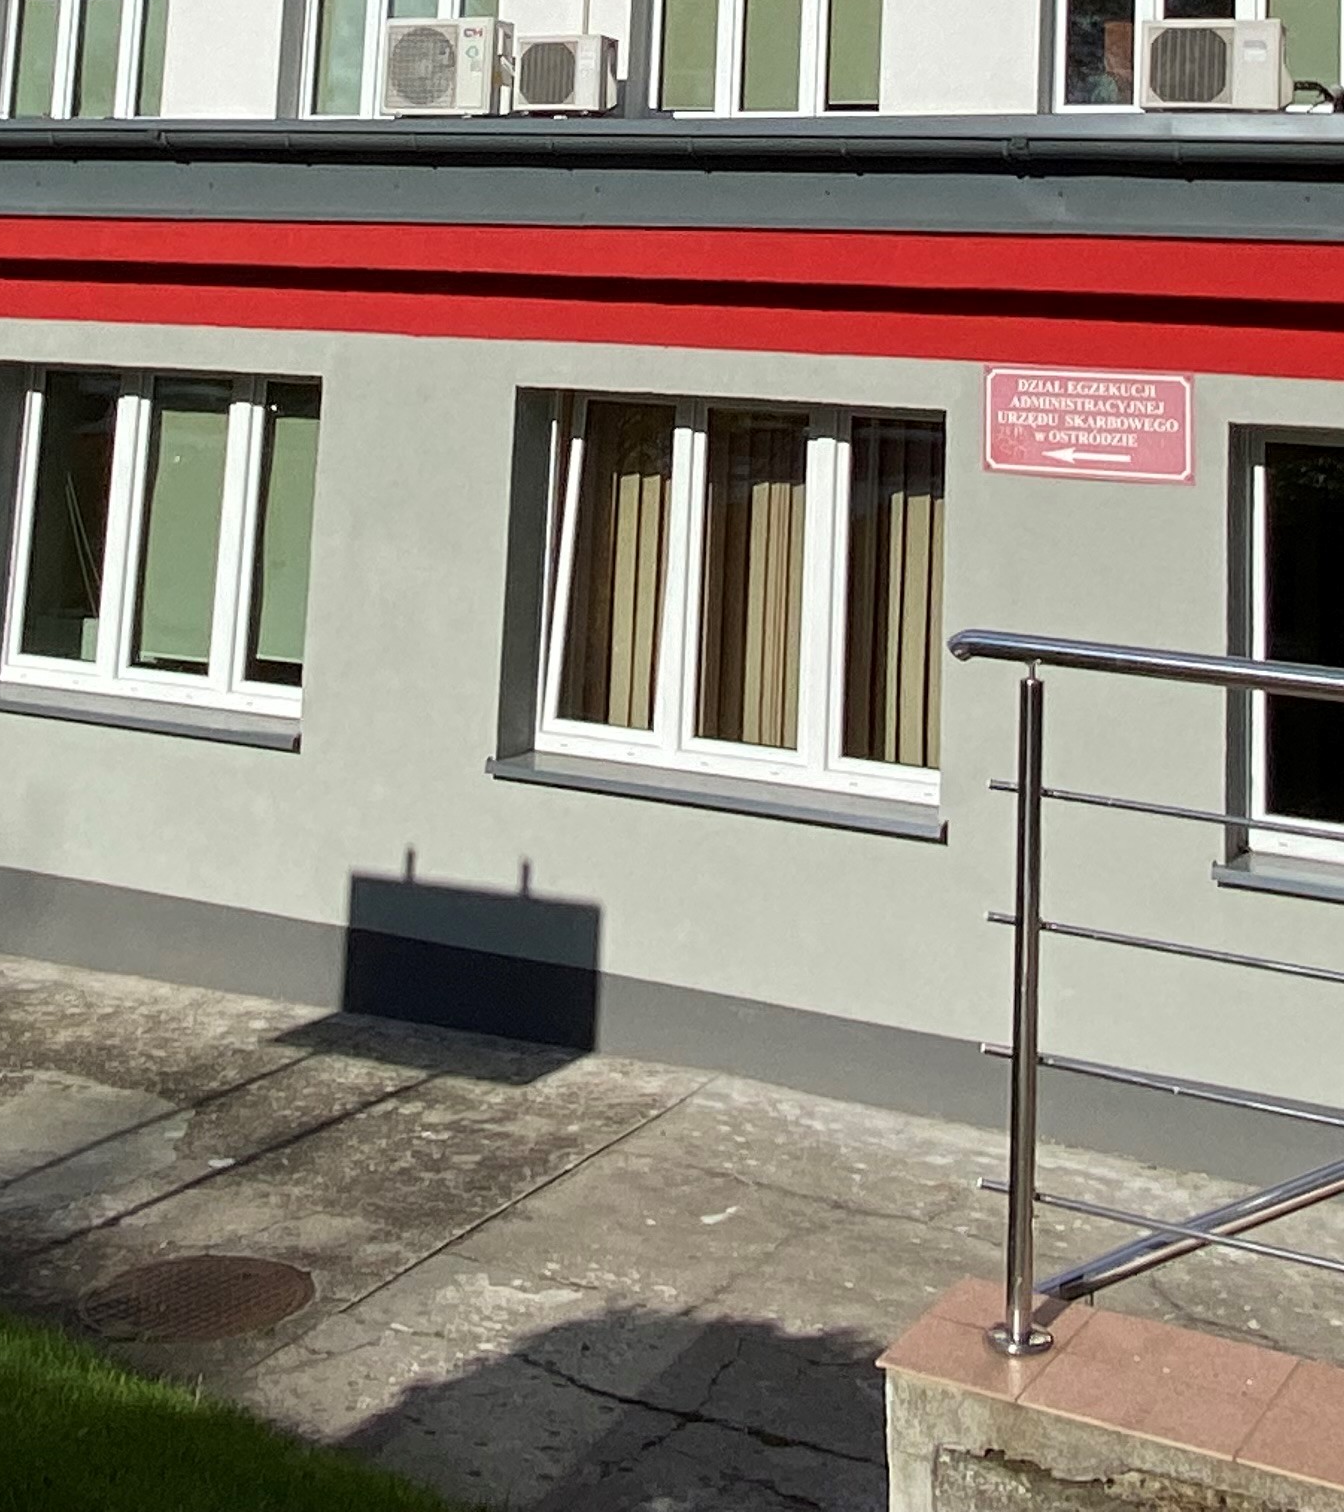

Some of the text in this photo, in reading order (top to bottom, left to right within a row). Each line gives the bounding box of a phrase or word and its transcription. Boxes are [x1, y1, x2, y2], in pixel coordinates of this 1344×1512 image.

[1067, 381, 1156, 398] EGZEKUCJI
[1009, 396, 1164, 414] ADMINISTRACYJNEJ
[997, 411, 1179, 433] URZĘDU SKARBOWEGO
[1035, 431, 1047, 442] w
[1048, 428, 1138, 448] OSTRÓDZIE
